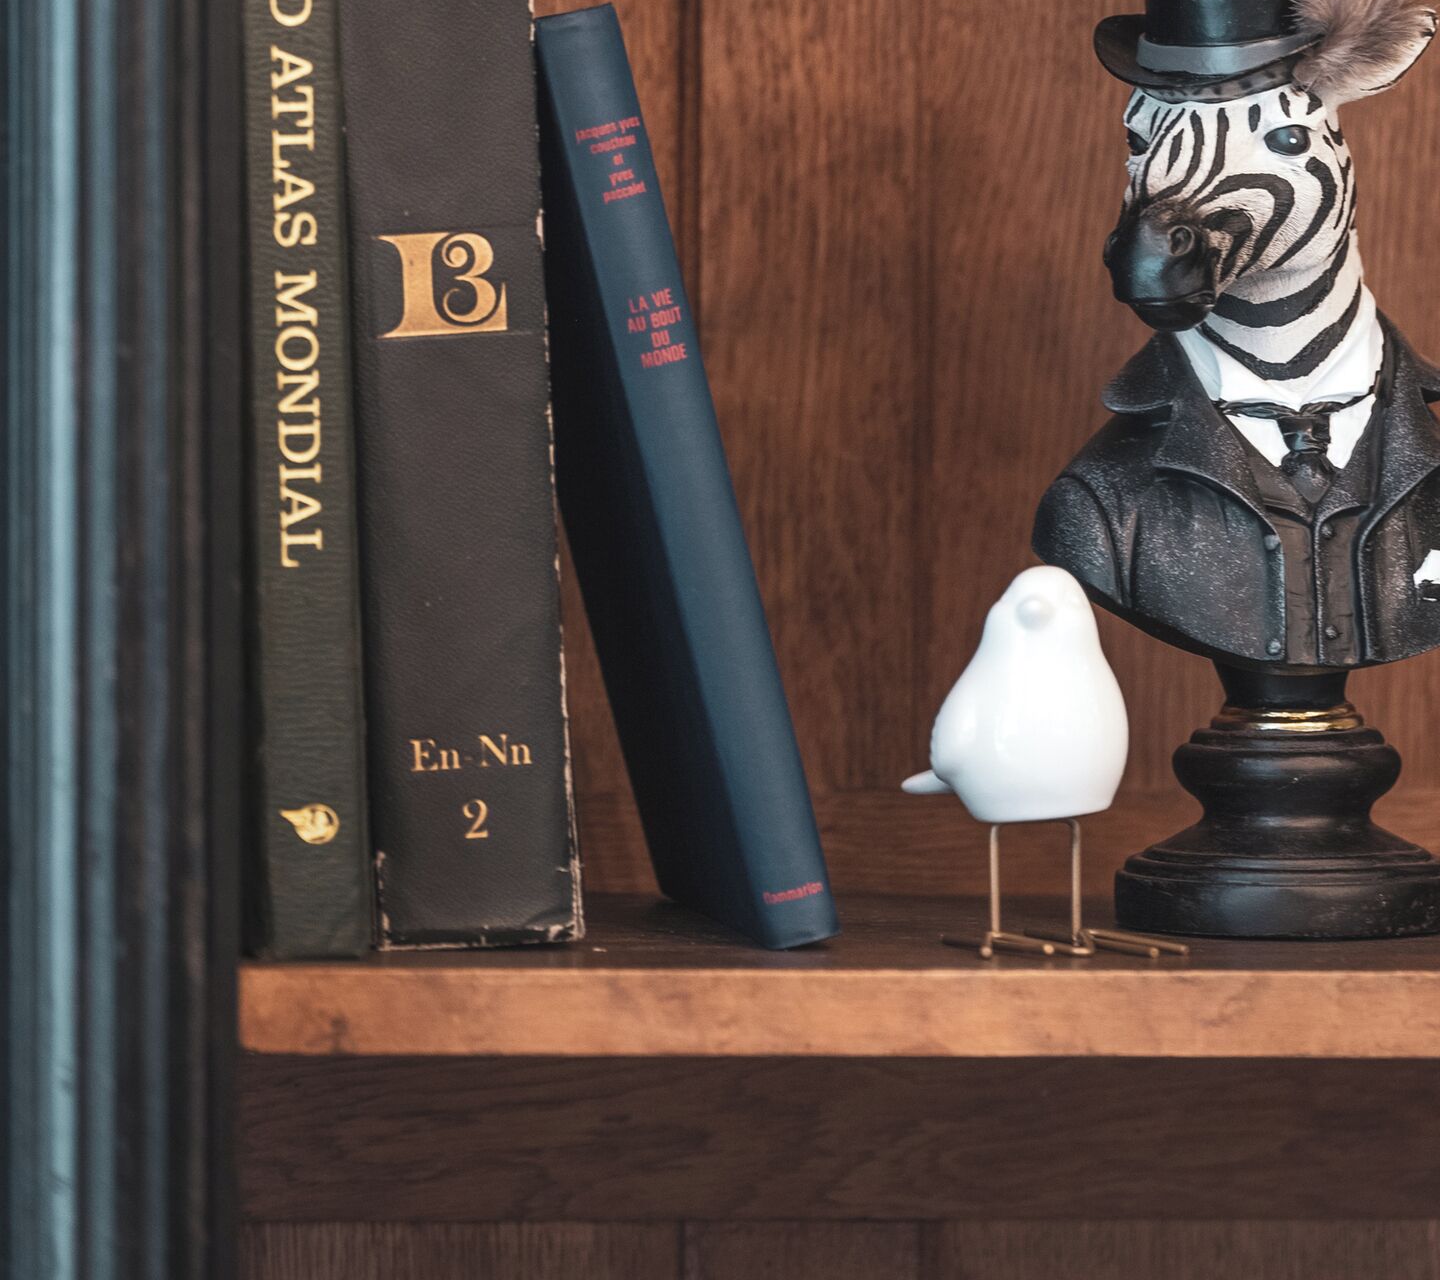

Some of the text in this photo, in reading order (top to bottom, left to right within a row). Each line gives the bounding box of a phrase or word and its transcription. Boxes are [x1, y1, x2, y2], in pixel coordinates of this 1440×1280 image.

[270, 44, 319, 248] ATLAS
[612, 153, 625, 166] et
[609, 169, 635, 187] yves
[628, 287, 673, 314] LA VIE
[627, 305, 682, 333] AU BOUT
[651, 330, 670, 348] DU
[640, 343, 688, 369] MONDE
[274, 269, 323, 568] MONDIAL
[462, 799, 490, 840] 2
